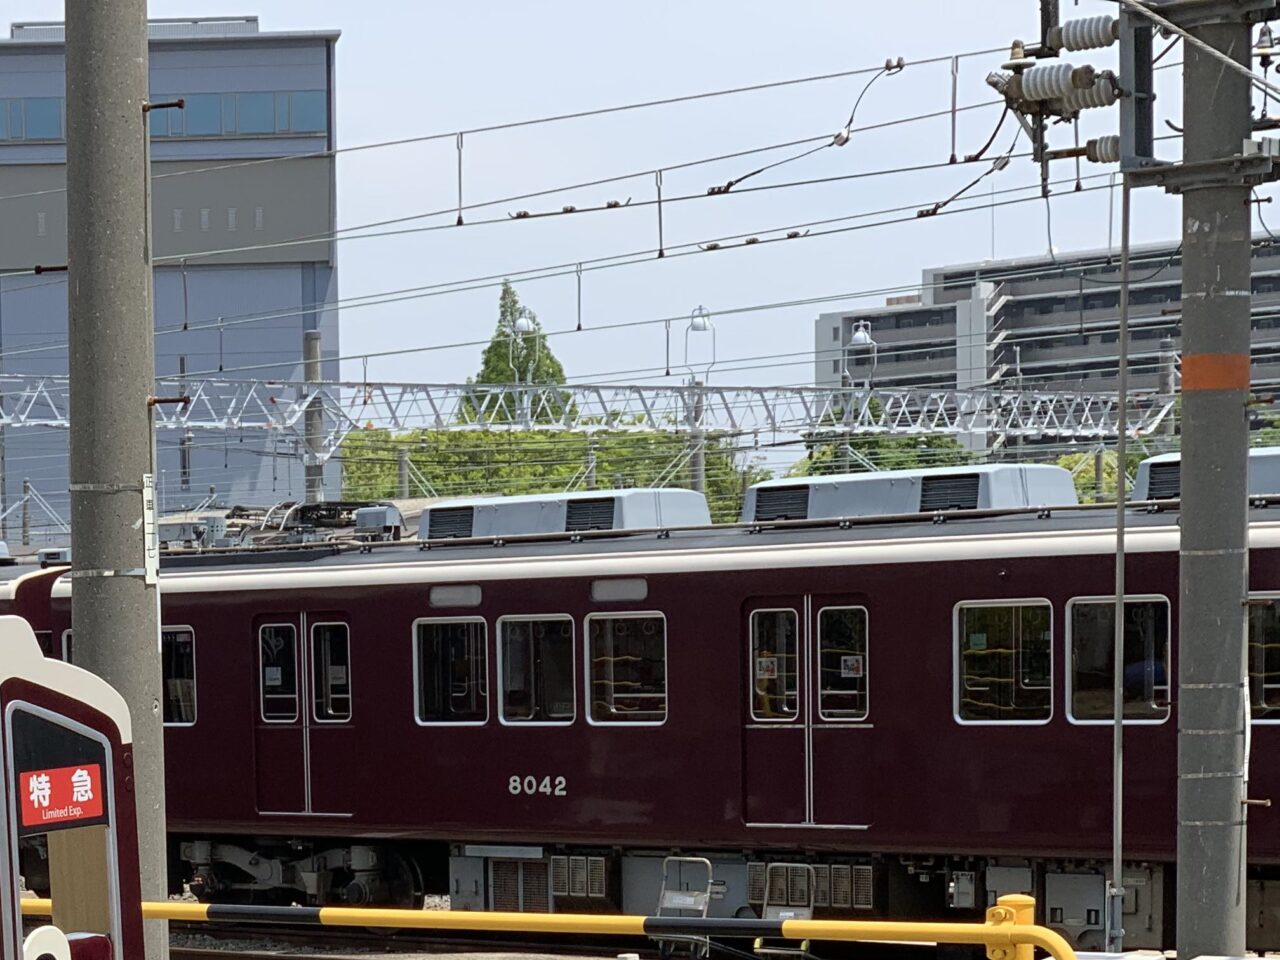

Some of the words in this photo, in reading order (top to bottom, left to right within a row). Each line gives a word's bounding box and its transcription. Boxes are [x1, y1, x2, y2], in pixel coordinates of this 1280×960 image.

[29, 769, 93, 808] 特急
[508, 775, 567, 796] 8042
[42, 806, 68, 819] Limited
[69, 805, 84, 818] Exp.
